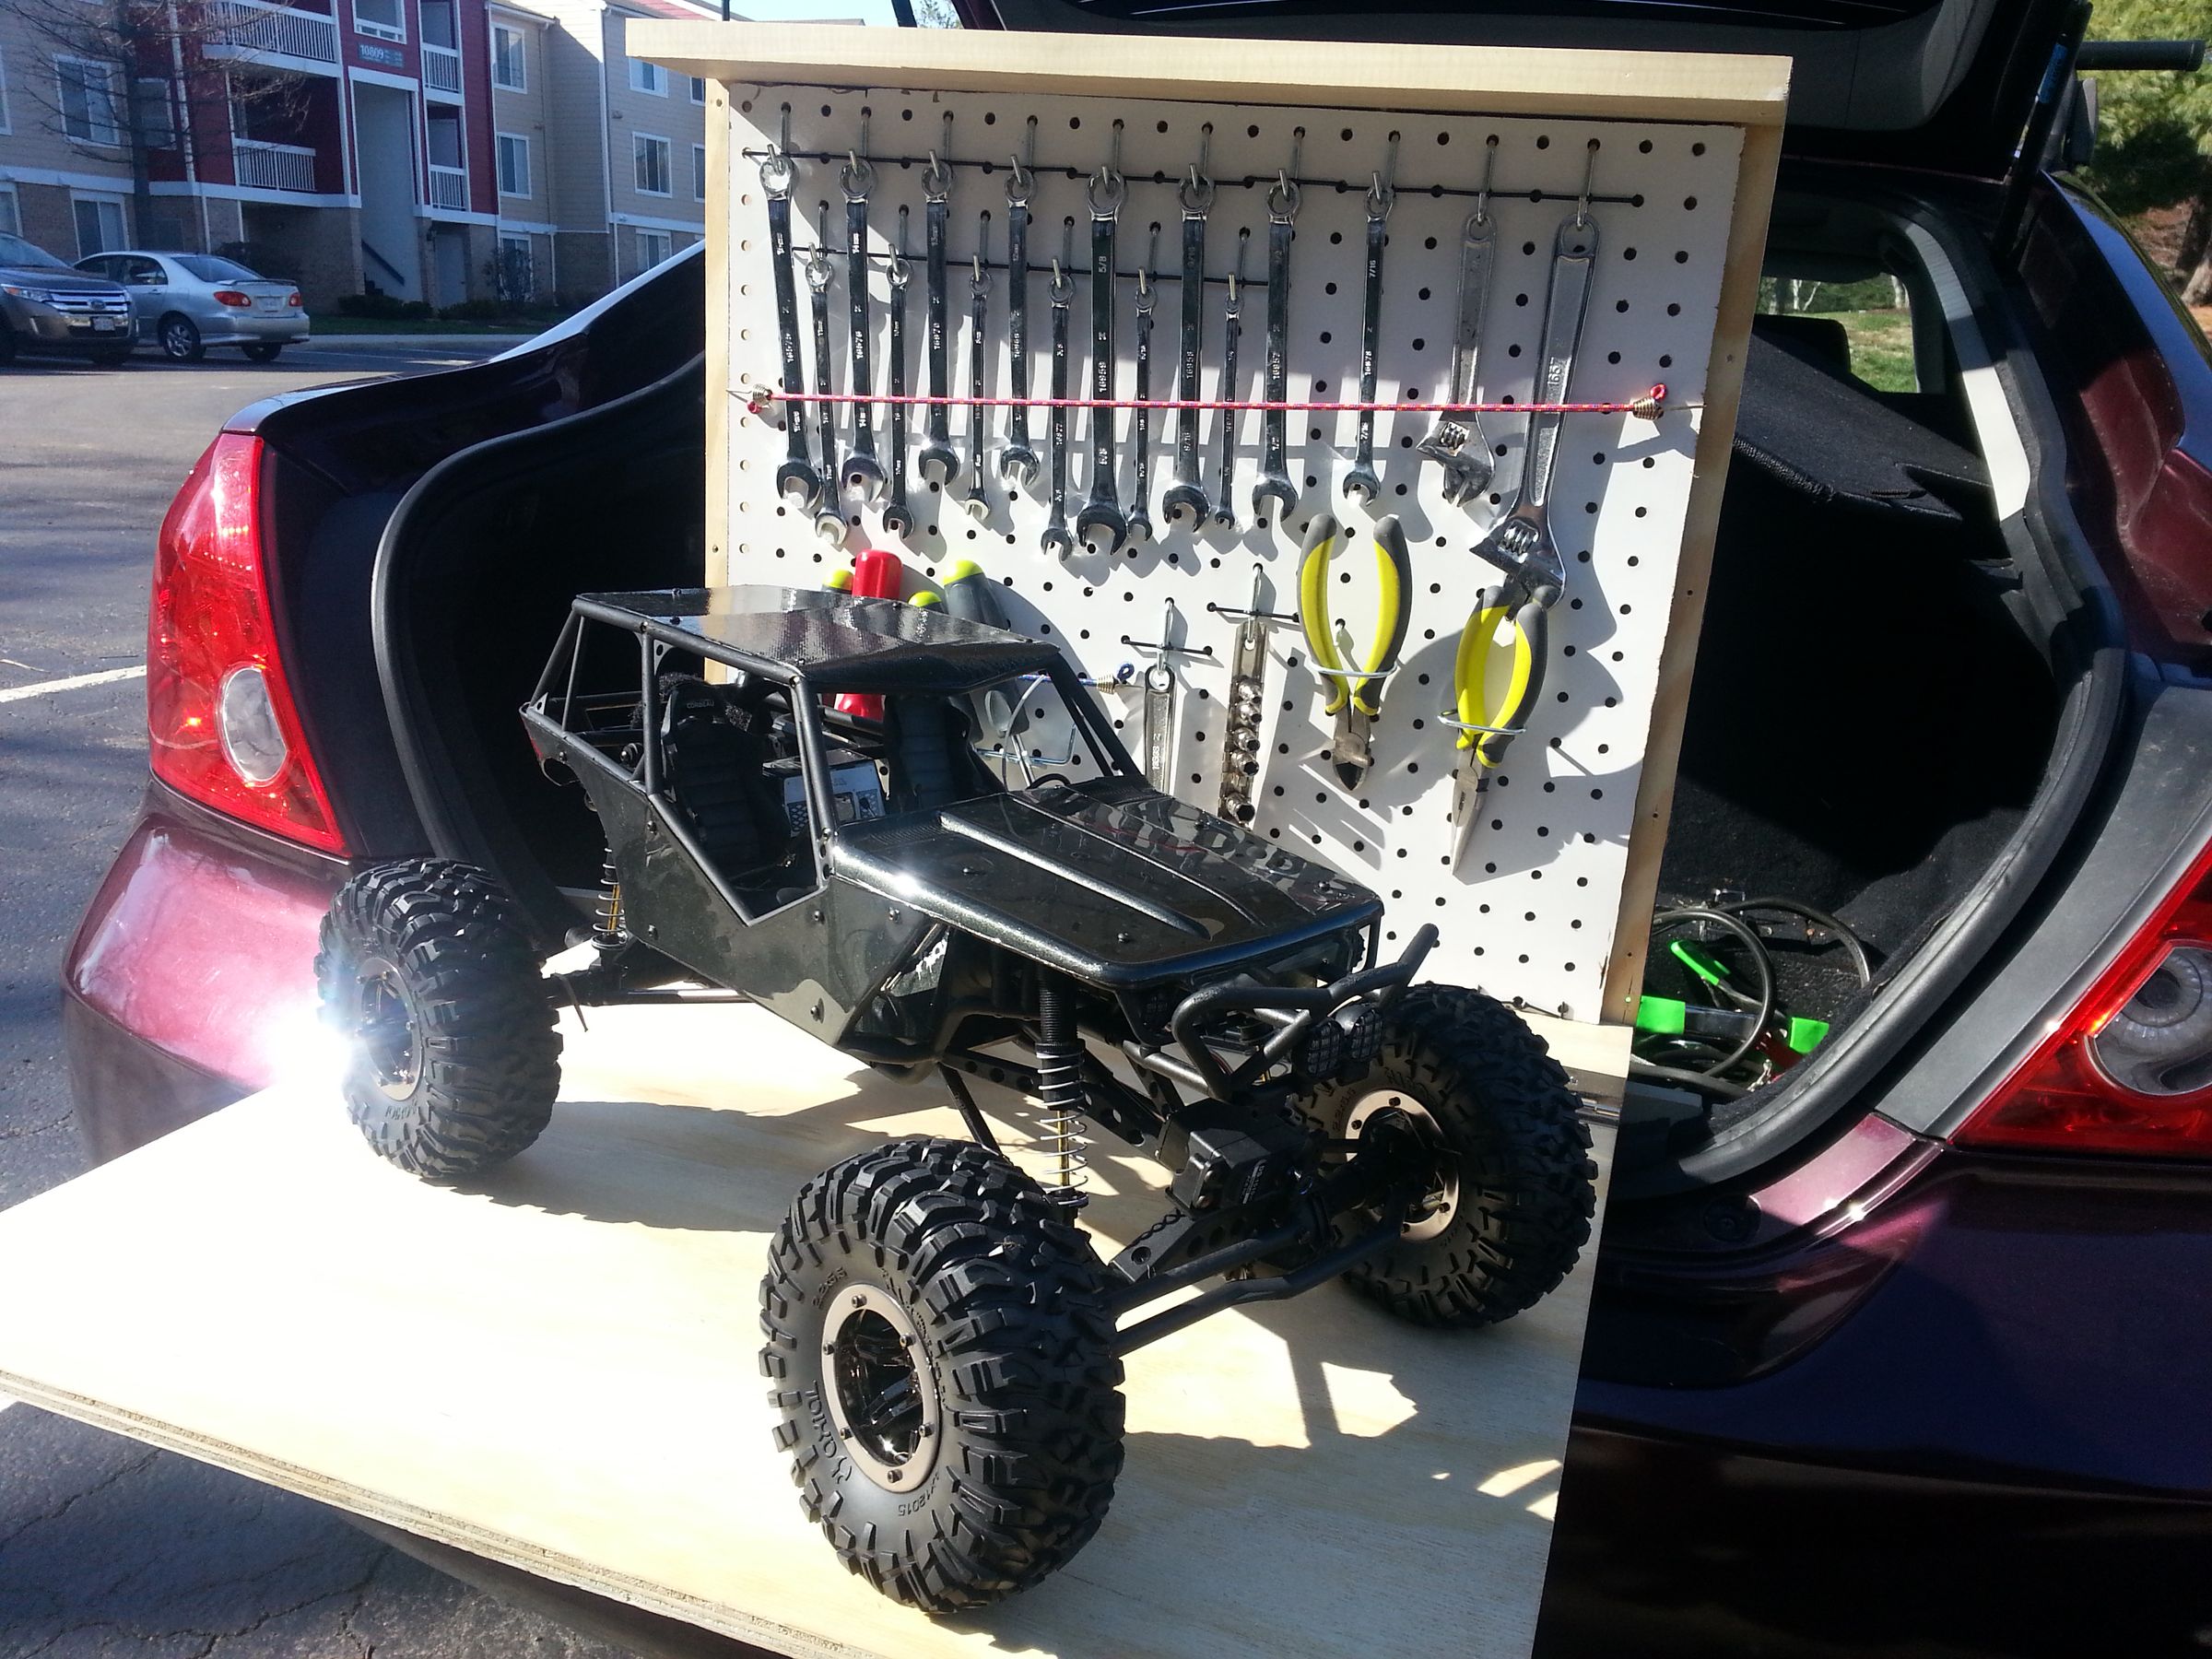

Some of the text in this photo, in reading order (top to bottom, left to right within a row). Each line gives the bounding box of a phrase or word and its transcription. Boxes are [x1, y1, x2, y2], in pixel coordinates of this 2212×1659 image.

[360, 44, 383, 58] 10809
[1099, 256, 1107, 272] 5/8
[1098, 361, 1107, 393] 16959
[1360, 421, 1369, 441] 7/16
